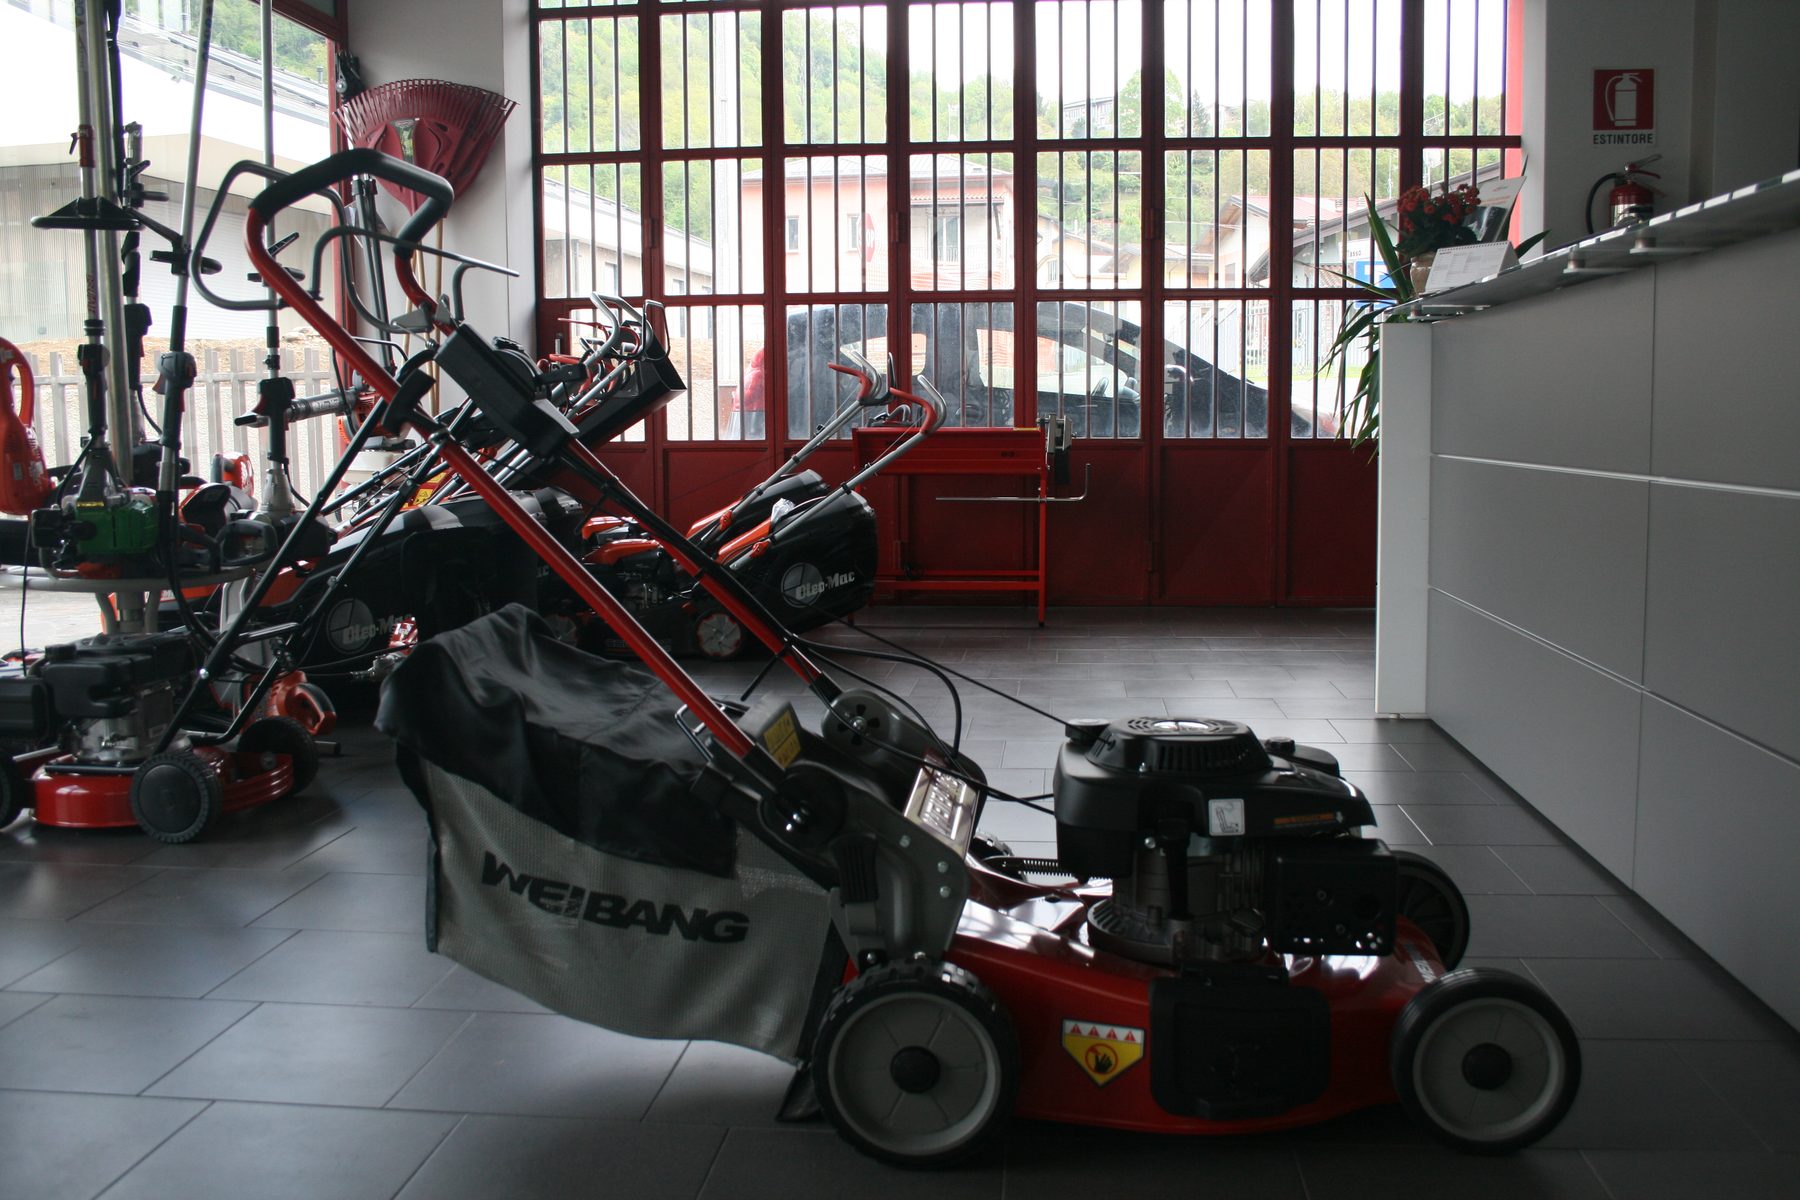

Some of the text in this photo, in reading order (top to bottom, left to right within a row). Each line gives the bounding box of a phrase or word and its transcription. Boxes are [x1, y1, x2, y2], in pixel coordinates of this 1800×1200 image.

[1593, 133, 1653, 145] ESTINTORE
[795, 571, 856, 601] Oleo-Mac
[342, 613, 404, 645] Oleo-M
[481, 851, 750, 943] WEIBANG
